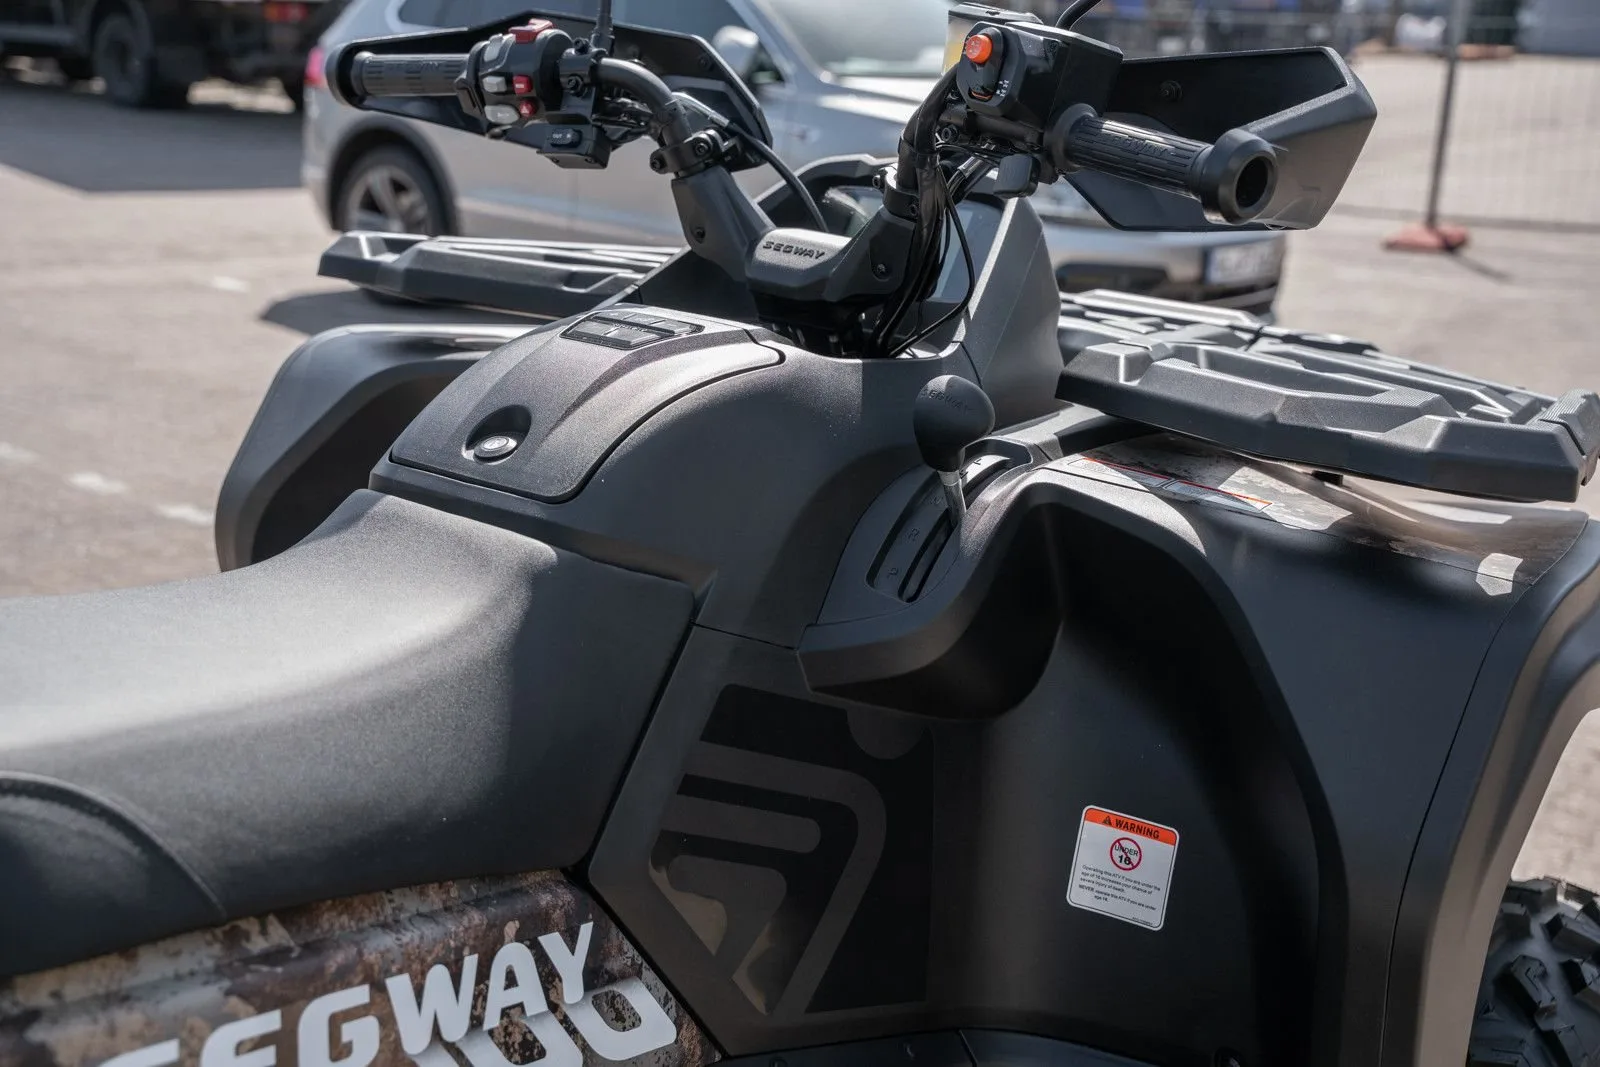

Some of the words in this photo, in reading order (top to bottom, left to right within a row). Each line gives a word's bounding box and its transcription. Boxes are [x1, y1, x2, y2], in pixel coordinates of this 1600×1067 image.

[763, 241, 825, 259] SEGWAY
[1115, 818, 1160, 840] WARNING
[1114, 844, 1139, 857] UNDER
[1118, 854, 1132, 866] 16
